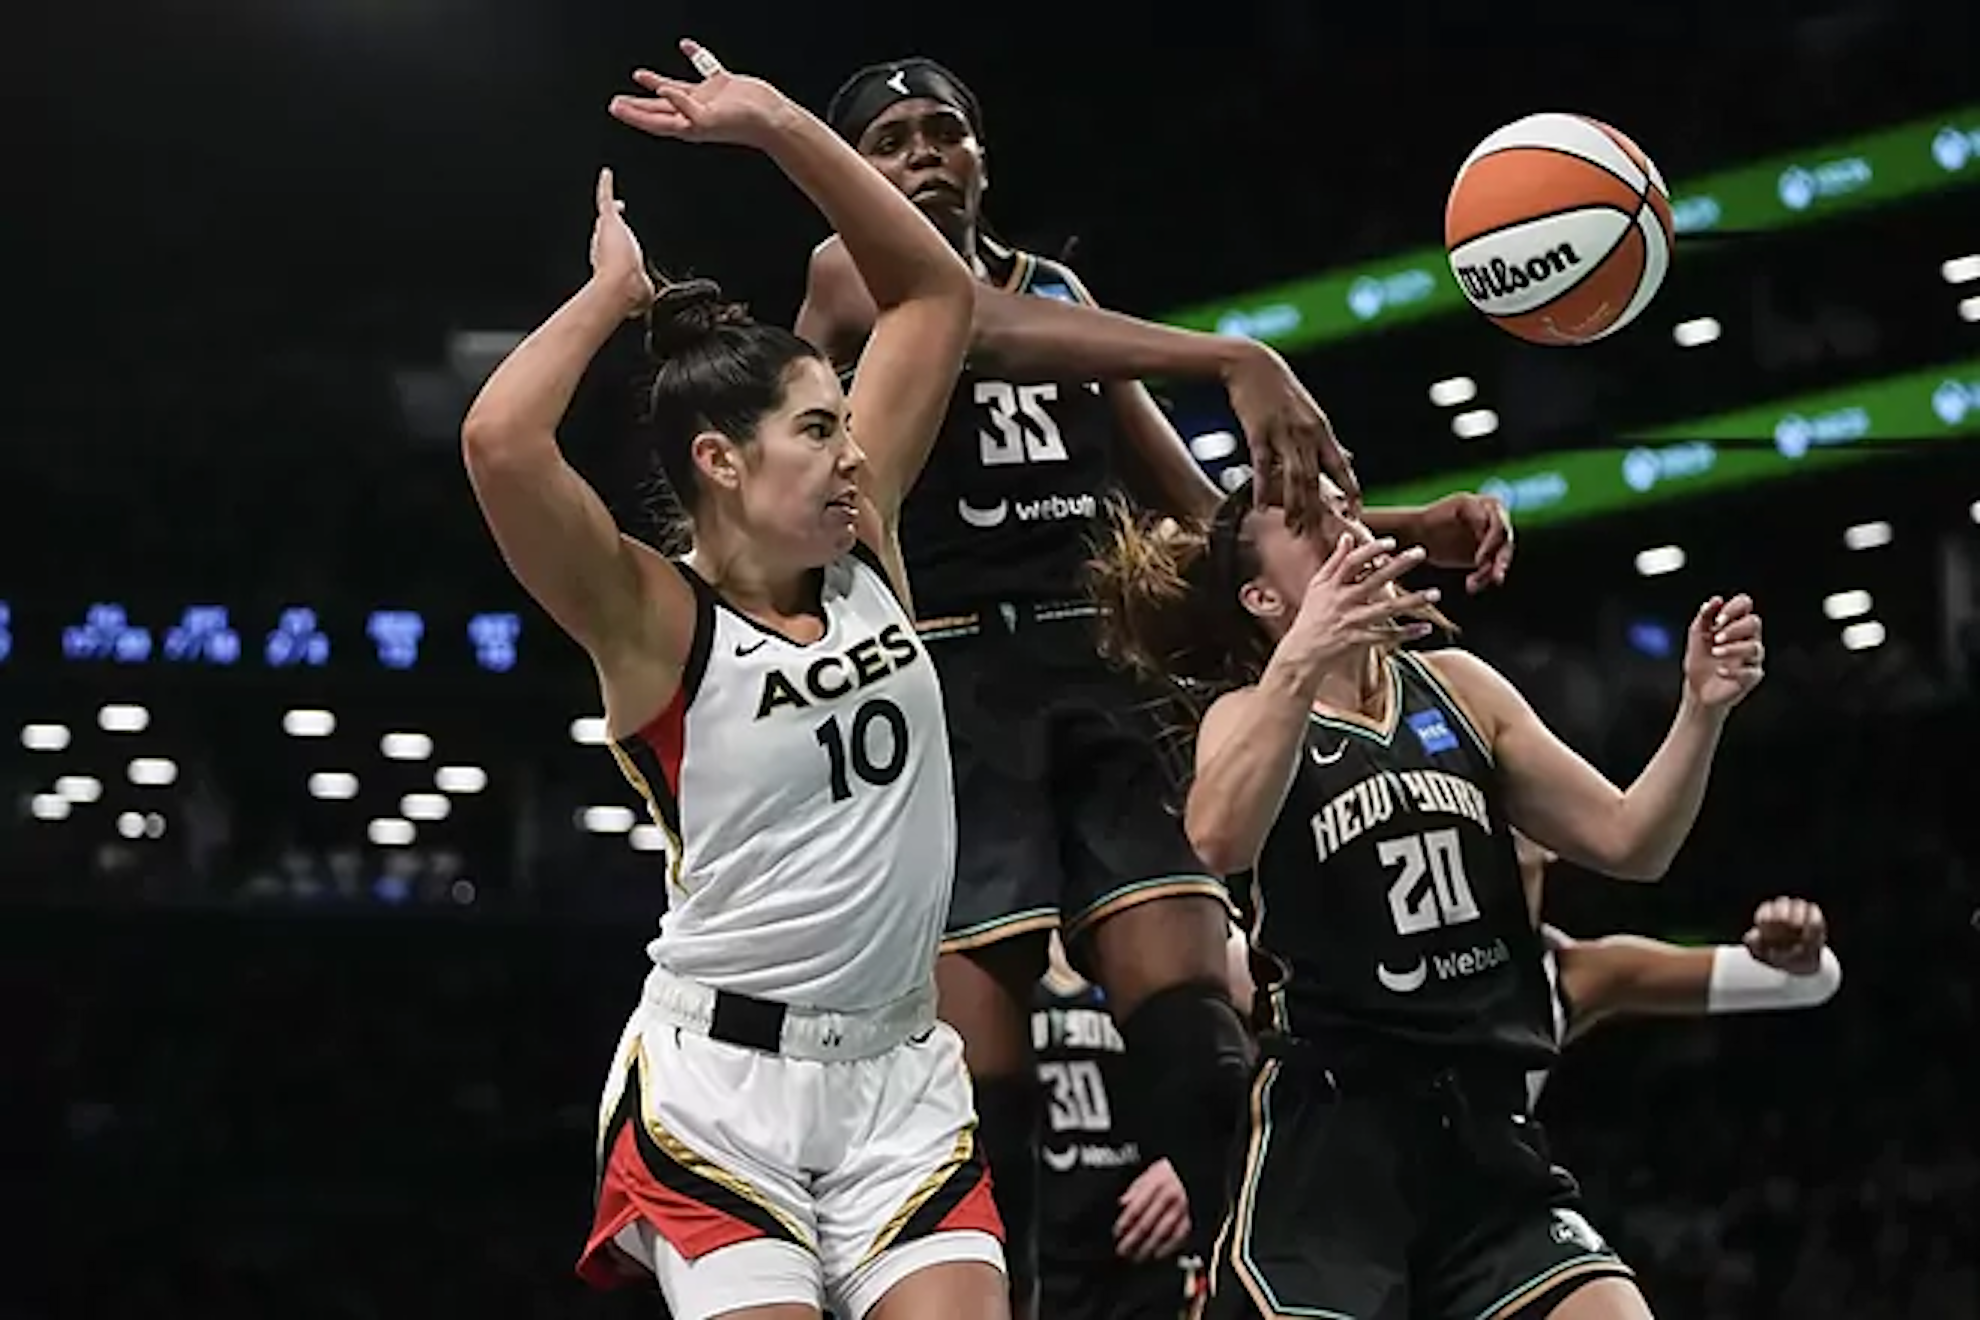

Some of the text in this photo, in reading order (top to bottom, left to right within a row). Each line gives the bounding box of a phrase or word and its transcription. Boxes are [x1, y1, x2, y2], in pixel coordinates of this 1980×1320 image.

[1458, 242, 1581, 300] Wilson
[973, 381, 1069, 466] 35
[753, 624, 918, 721] ACES
[814, 696, 909, 803] 10
[1310, 769, 1493, 863] NEW YORK
[1375, 827, 1480, 935] 20
[1037, 1061, 1112, 1132] 30
